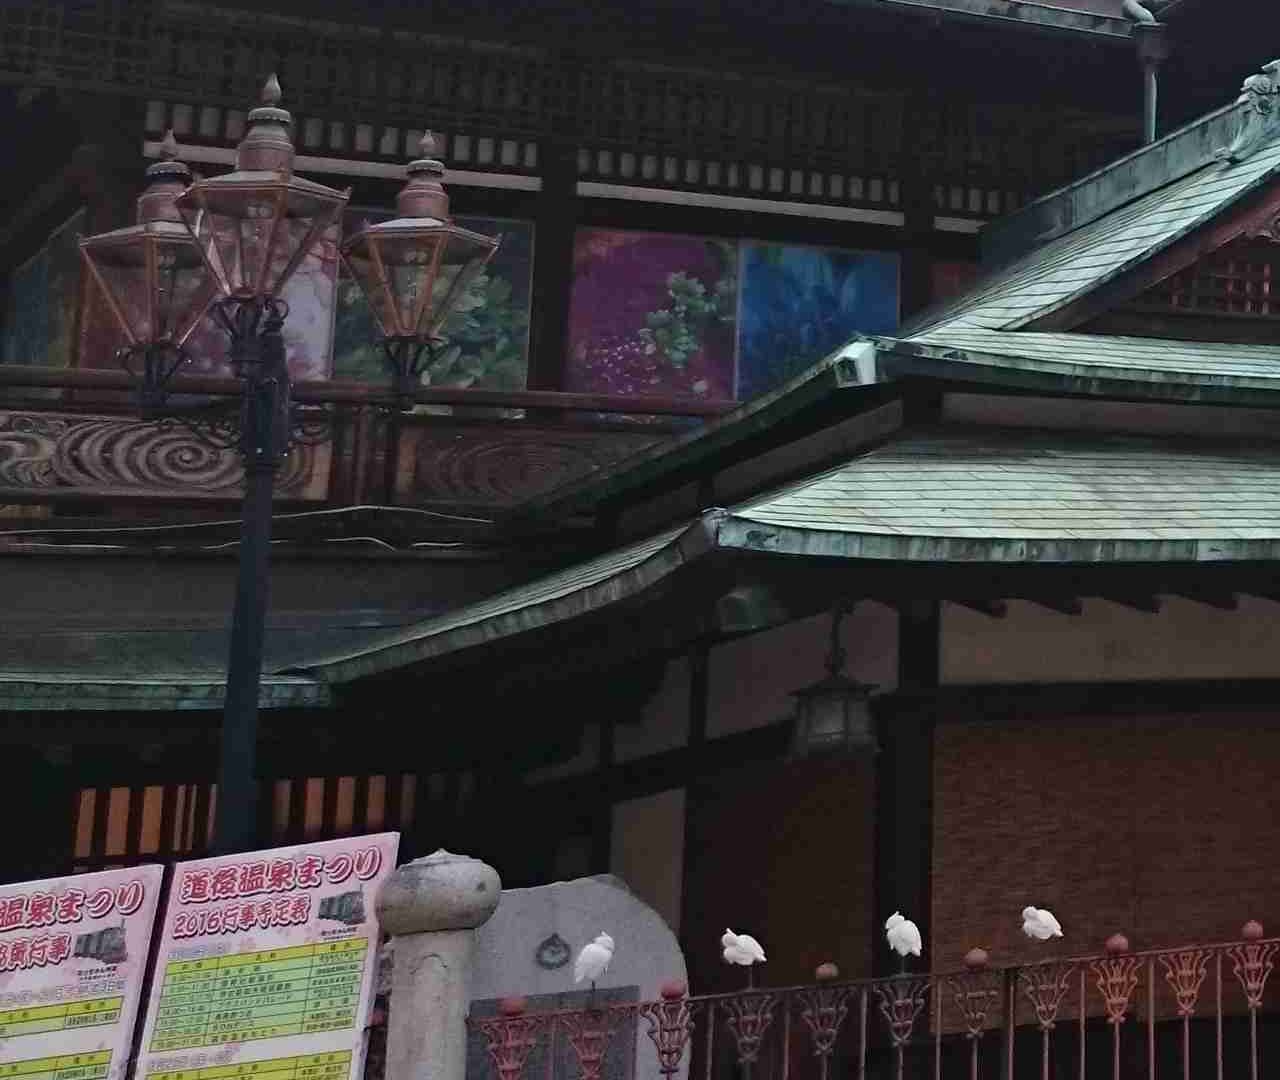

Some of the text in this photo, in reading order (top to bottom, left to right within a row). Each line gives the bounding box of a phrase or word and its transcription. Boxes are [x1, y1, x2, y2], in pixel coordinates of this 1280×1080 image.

[180, 846, 382, 904] 道後温泉まつり
